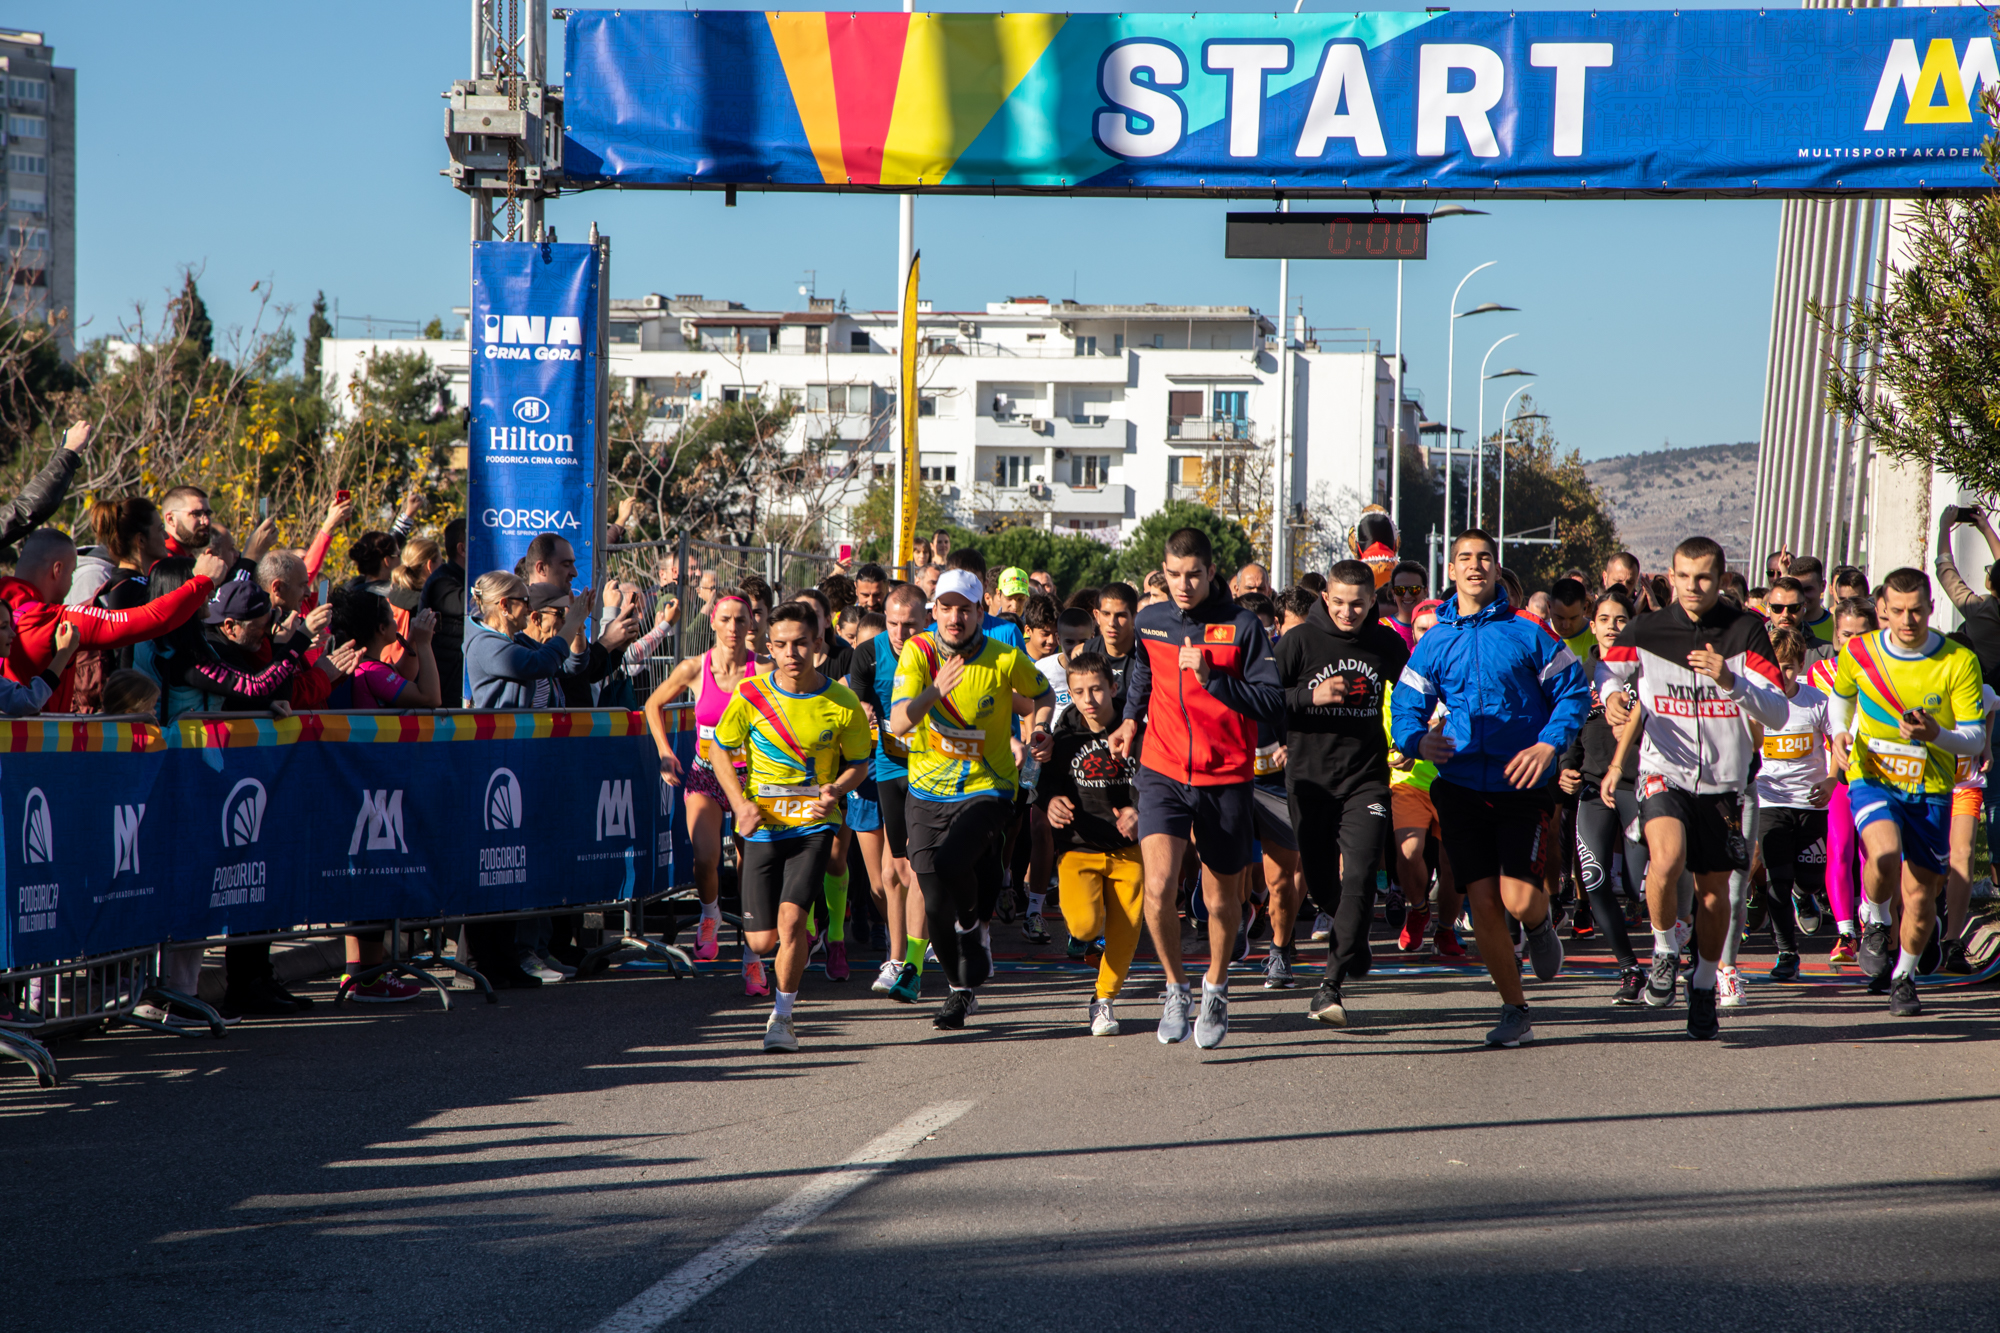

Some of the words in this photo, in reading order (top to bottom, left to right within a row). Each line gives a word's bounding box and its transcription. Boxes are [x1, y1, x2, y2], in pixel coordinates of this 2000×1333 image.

[1098, 42, 1614, 157] START
[1798, 148, 1907, 158] MULTISPORT
[1912, 147, 1986, 157] AKADEM
[484, 314, 582, 345] INA
[484, 344, 531, 360] CRNA
[534, 346, 582, 361] GORA
[489, 426, 574, 452] Hilton
[485, 455, 529, 464] PODGORICA
[531, 456, 553, 465] CRNA
[555, 457, 578, 465] GORA
[482, 508, 582, 530] GORSKA
[1140, 627, 1168, 639] DIADORA
[1307, 658, 1382, 695] OMLADINAC
[1666, 683, 1720, 701] MMA
[1305, 706, 1379, 718] MONTENEGRO
[941, 737, 981, 756] 621
[1070, 738, 1136, 769] OMLADC
[1776, 736, 1812, 753] 1241
[773, 799, 815, 818] 422
[479, 845, 526, 871] PODGORICA
[212, 860, 266, 891] PODGORICA
[321, 867, 367, 878] MULTISPORT
[478, 869, 513, 887] MILLENNIUM
[515, 868, 526, 883] RUN
[18, 883, 59, 914] PODGORICA
[250, 886, 266, 903] RUN
